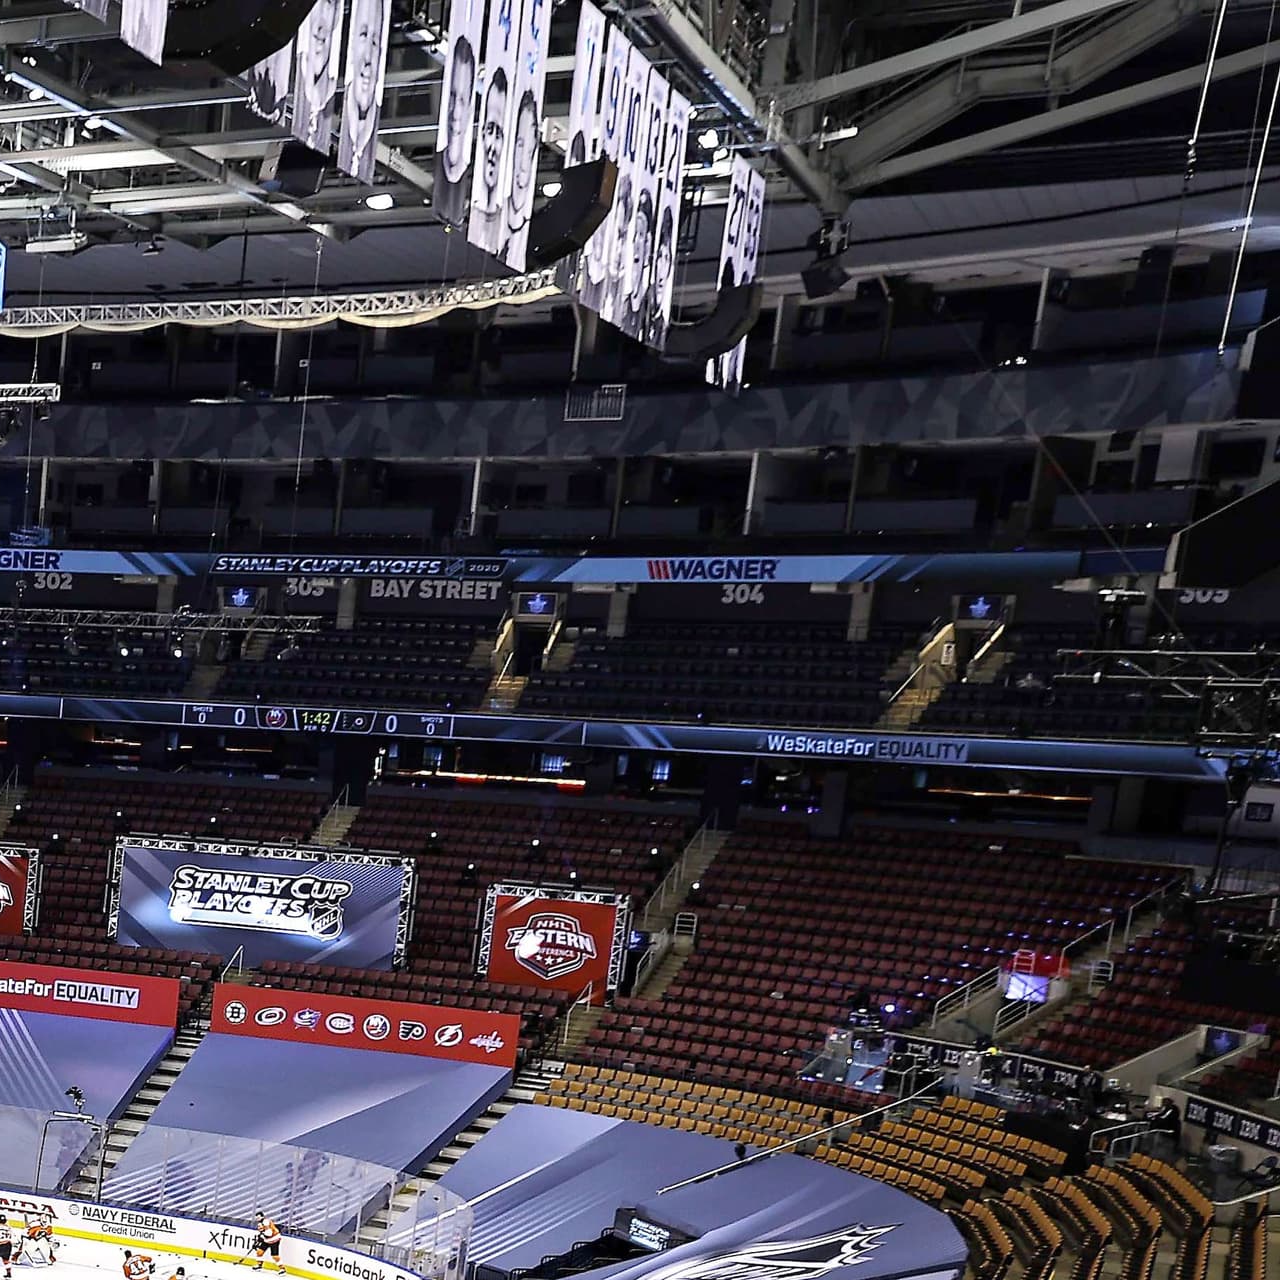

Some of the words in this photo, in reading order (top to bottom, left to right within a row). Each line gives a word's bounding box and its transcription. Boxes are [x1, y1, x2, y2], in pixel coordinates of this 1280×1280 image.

[607, 66, 621, 140] 9
[623, 88, 642, 163] 10
[644, 103, 662, 176] 13
[666, 124, 684, 194] 21
[215, 557, 300, 571] STANLEY
[298, 558, 341, 573] CUP
[341, 560, 441, 574] PLAYOFFS
[468, 564, 500, 572] 2020
[669, 559, 777, 580] WAGNER
[33, 572, 73, 590] 302
[370, 579, 413, 599] BAY
[418, 580, 503, 601] STREET
[721, 584, 765, 604] 304
[198, 713, 206, 724] 0
[234, 709, 246, 726] 0
[301, 711, 331, 725] 1:42
[385, 715, 398, 733] 0
[426, 723, 435, 735] 0
[767, 735, 874, 756] WeSkateFor
[879, 740, 966, 760] EQUALITY
[175, 868, 290, 896] STANLEY
[290, 877, 351, 900] CUP
[174, 889, 305, 917] PLAYOFFS
[313, 913, 337, 933] NHL
[536, 920, 571, 930] NHL
[510, 929, 593, 953] EASTERN
[56, 981, 137, 1006] EQUALITY
[82, 1206, 120, 1221] NAVY
[123, 1211, 177, 1231] FEDERAL
[101, 1223, 129, 1237] Credit
[130, 1227, 156, 1241] Union
